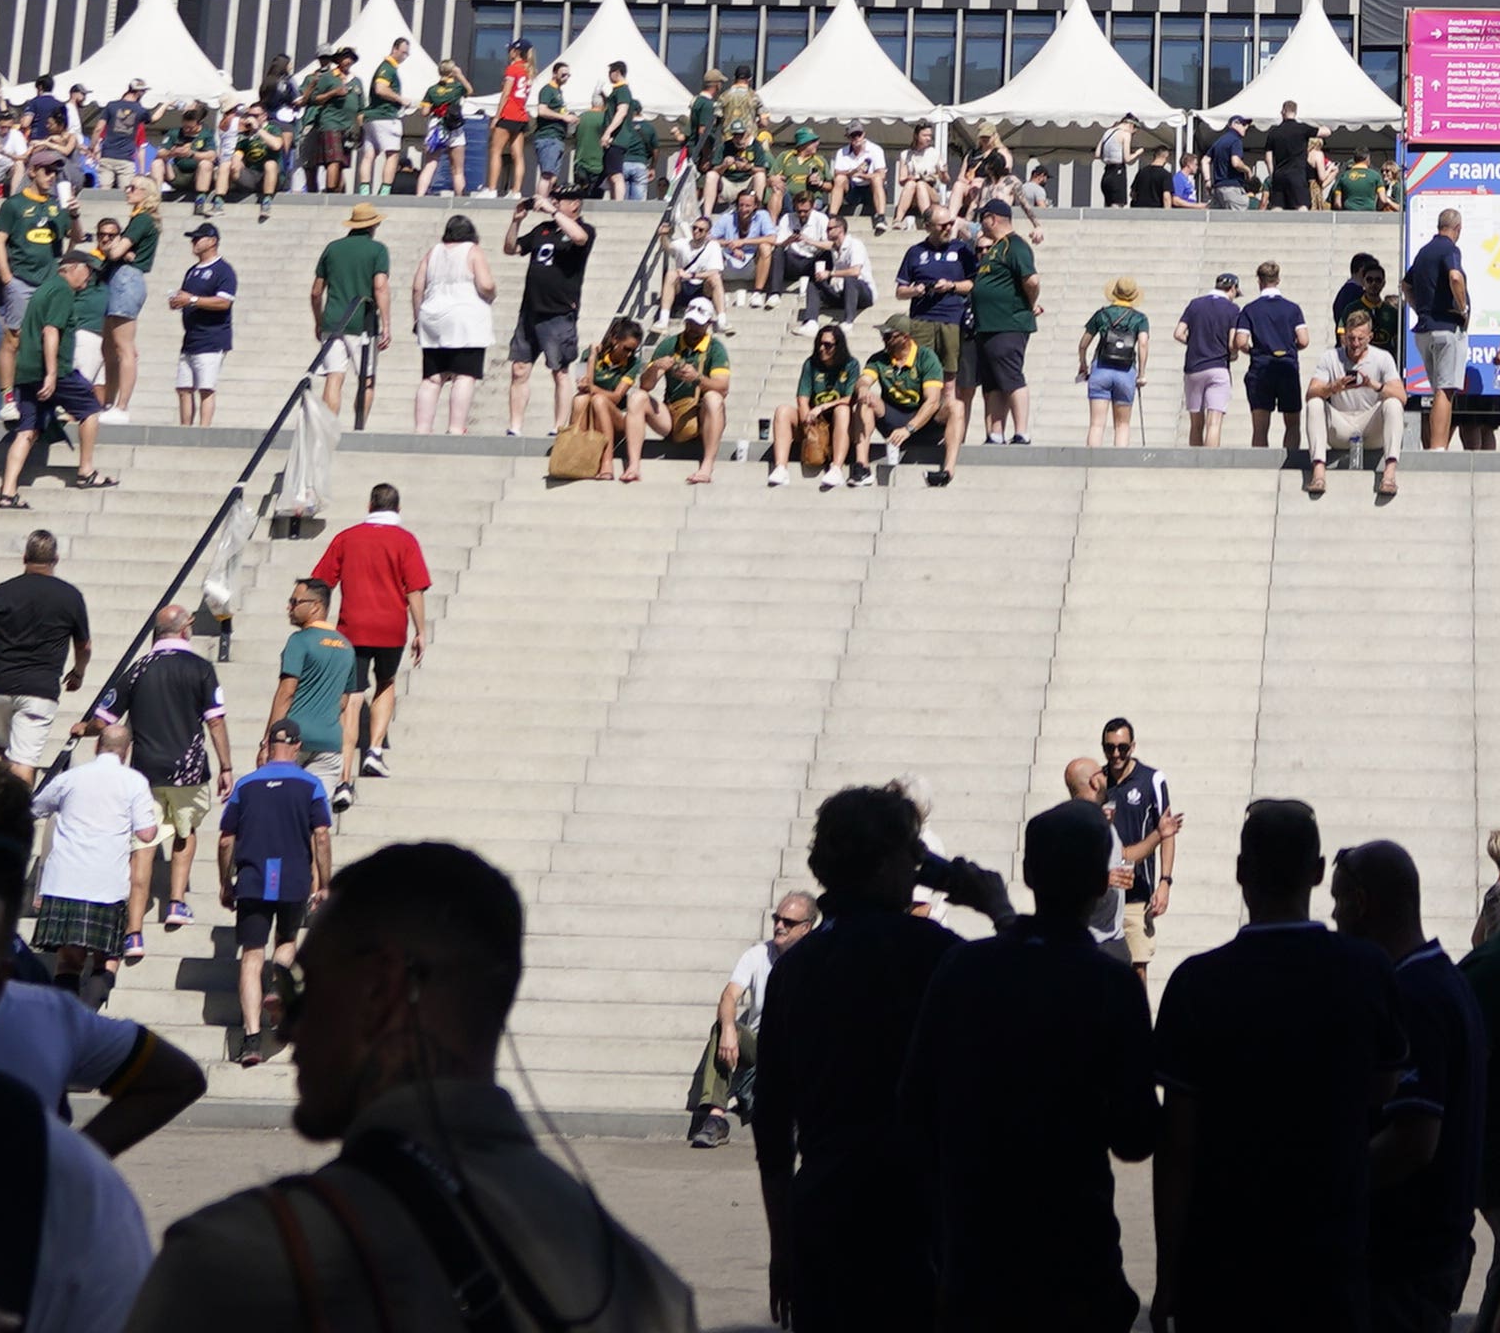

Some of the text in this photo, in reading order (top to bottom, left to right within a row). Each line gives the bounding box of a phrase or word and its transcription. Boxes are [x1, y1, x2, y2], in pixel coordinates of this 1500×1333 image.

[1448, 34, 1480, 43] Boutiques
[1479, 42, 1494, 50] Gate
[1447, 85, 1480, 95] Hospitality
[1481, 94, 1497, 102] Food
[1447, 101, 1480, 110] Boutiques
[1447, 121, 1480, 131] Consignes
[1485, 122, 1498, 131] Bag
